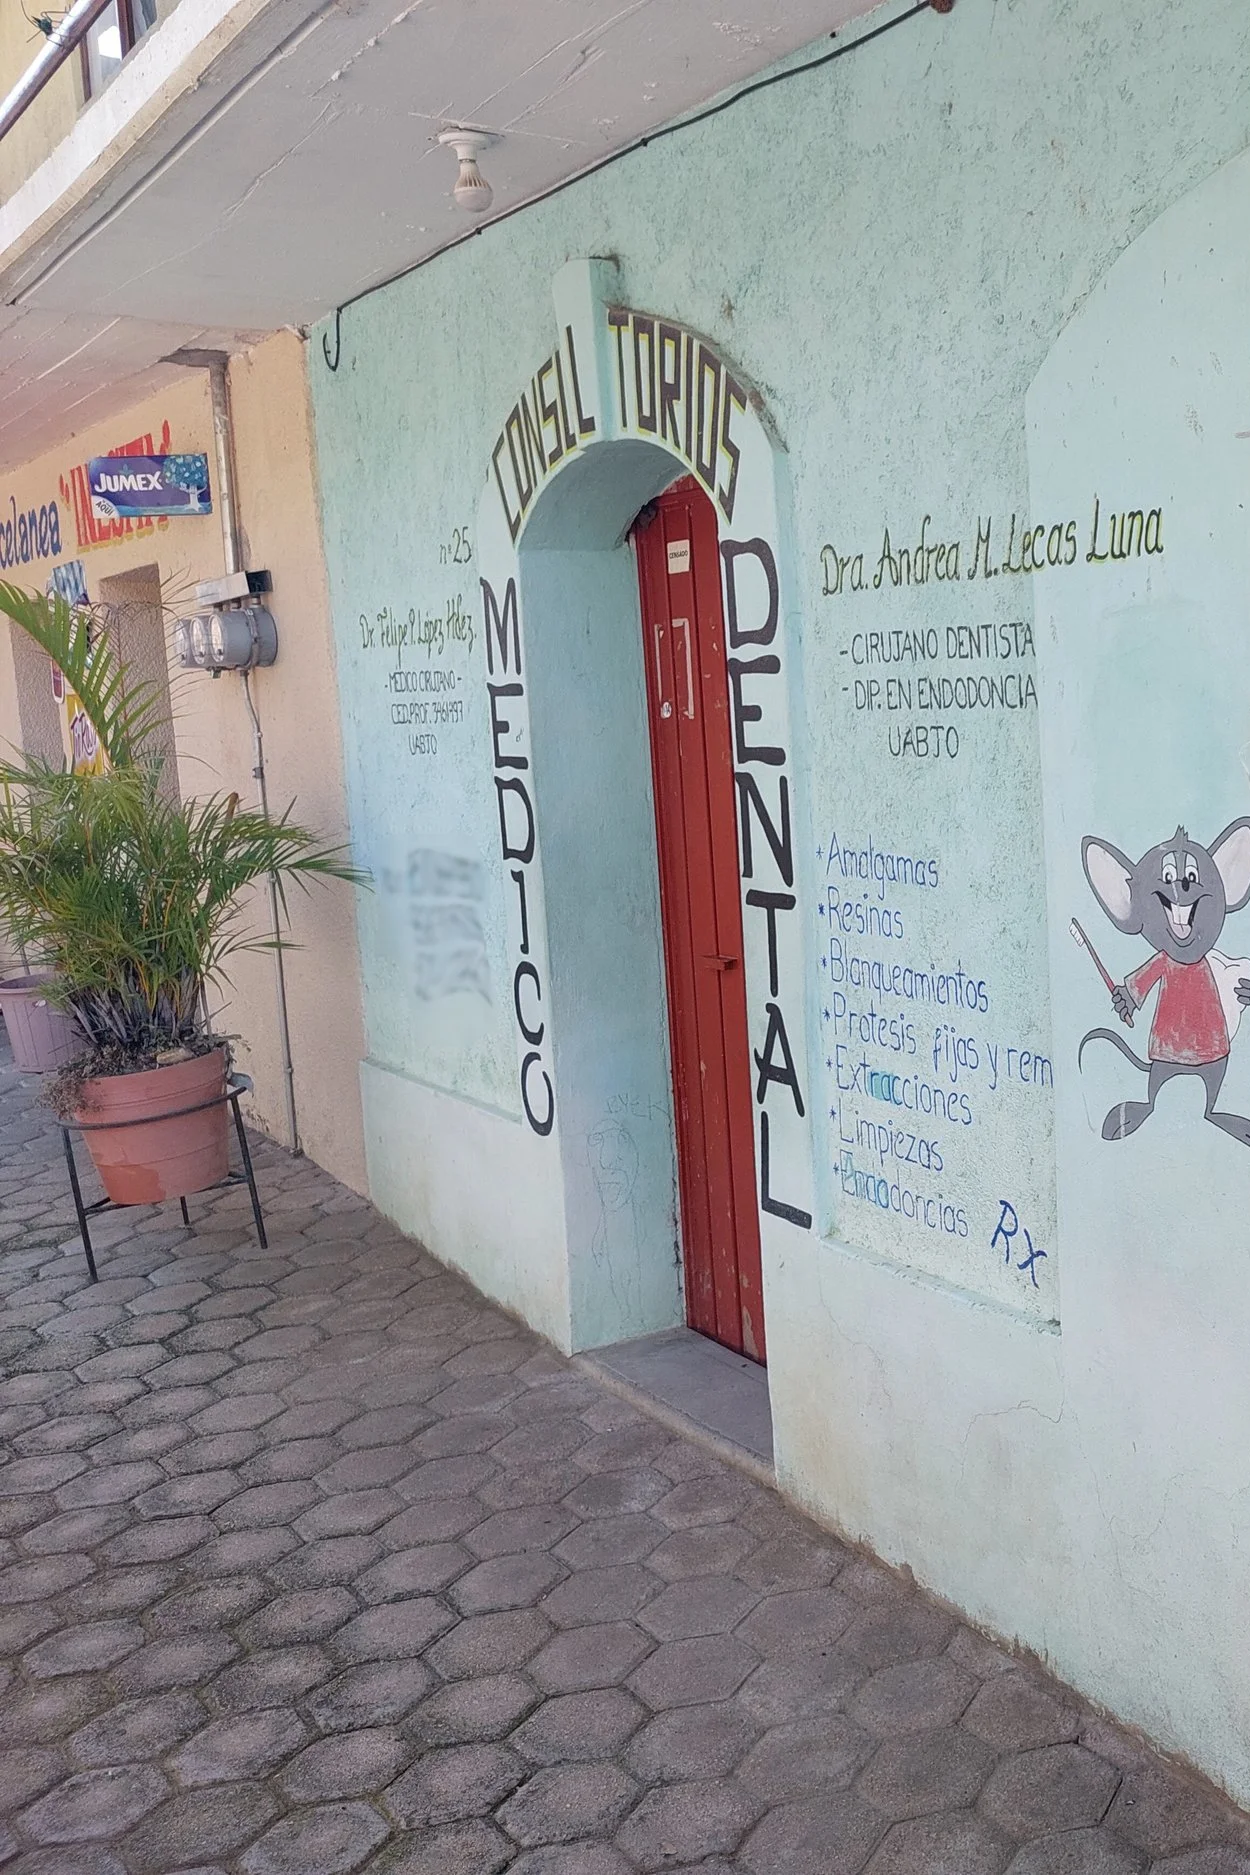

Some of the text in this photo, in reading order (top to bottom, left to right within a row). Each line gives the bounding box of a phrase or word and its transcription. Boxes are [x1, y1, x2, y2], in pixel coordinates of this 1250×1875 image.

[94, 471, 164, 493] JUMEX
[820, 543, 869, 596] Dra.
[873, 514, 961, 590] Andrea
[1086, 498, 1165, 564] Luna
[376, 606, 408, 670] Felipe
[945, 621, 1037, 660] DENTISTA
[886, 677, 913, 711] EN
[918, 672, 1039, 711] ENDODONCIA
[719, 535, 812, 1229] DENTAL
[826, 832, 940, 900] Amalgamas
[827, 885, 904, 939] Resinas
[830, 937, 989, 1013] Blanqueamientos
[833, 991, 917, 1055] Protesis
[932, 1024, 980, 1084] fijas
[986, 1042, 999, 1091] y
[835, 1044, 973, 1126] Extracciones
[838, 1096, 945, 1172] Limpiezas
[839, 1148, 970, 1238] Endodoncias
